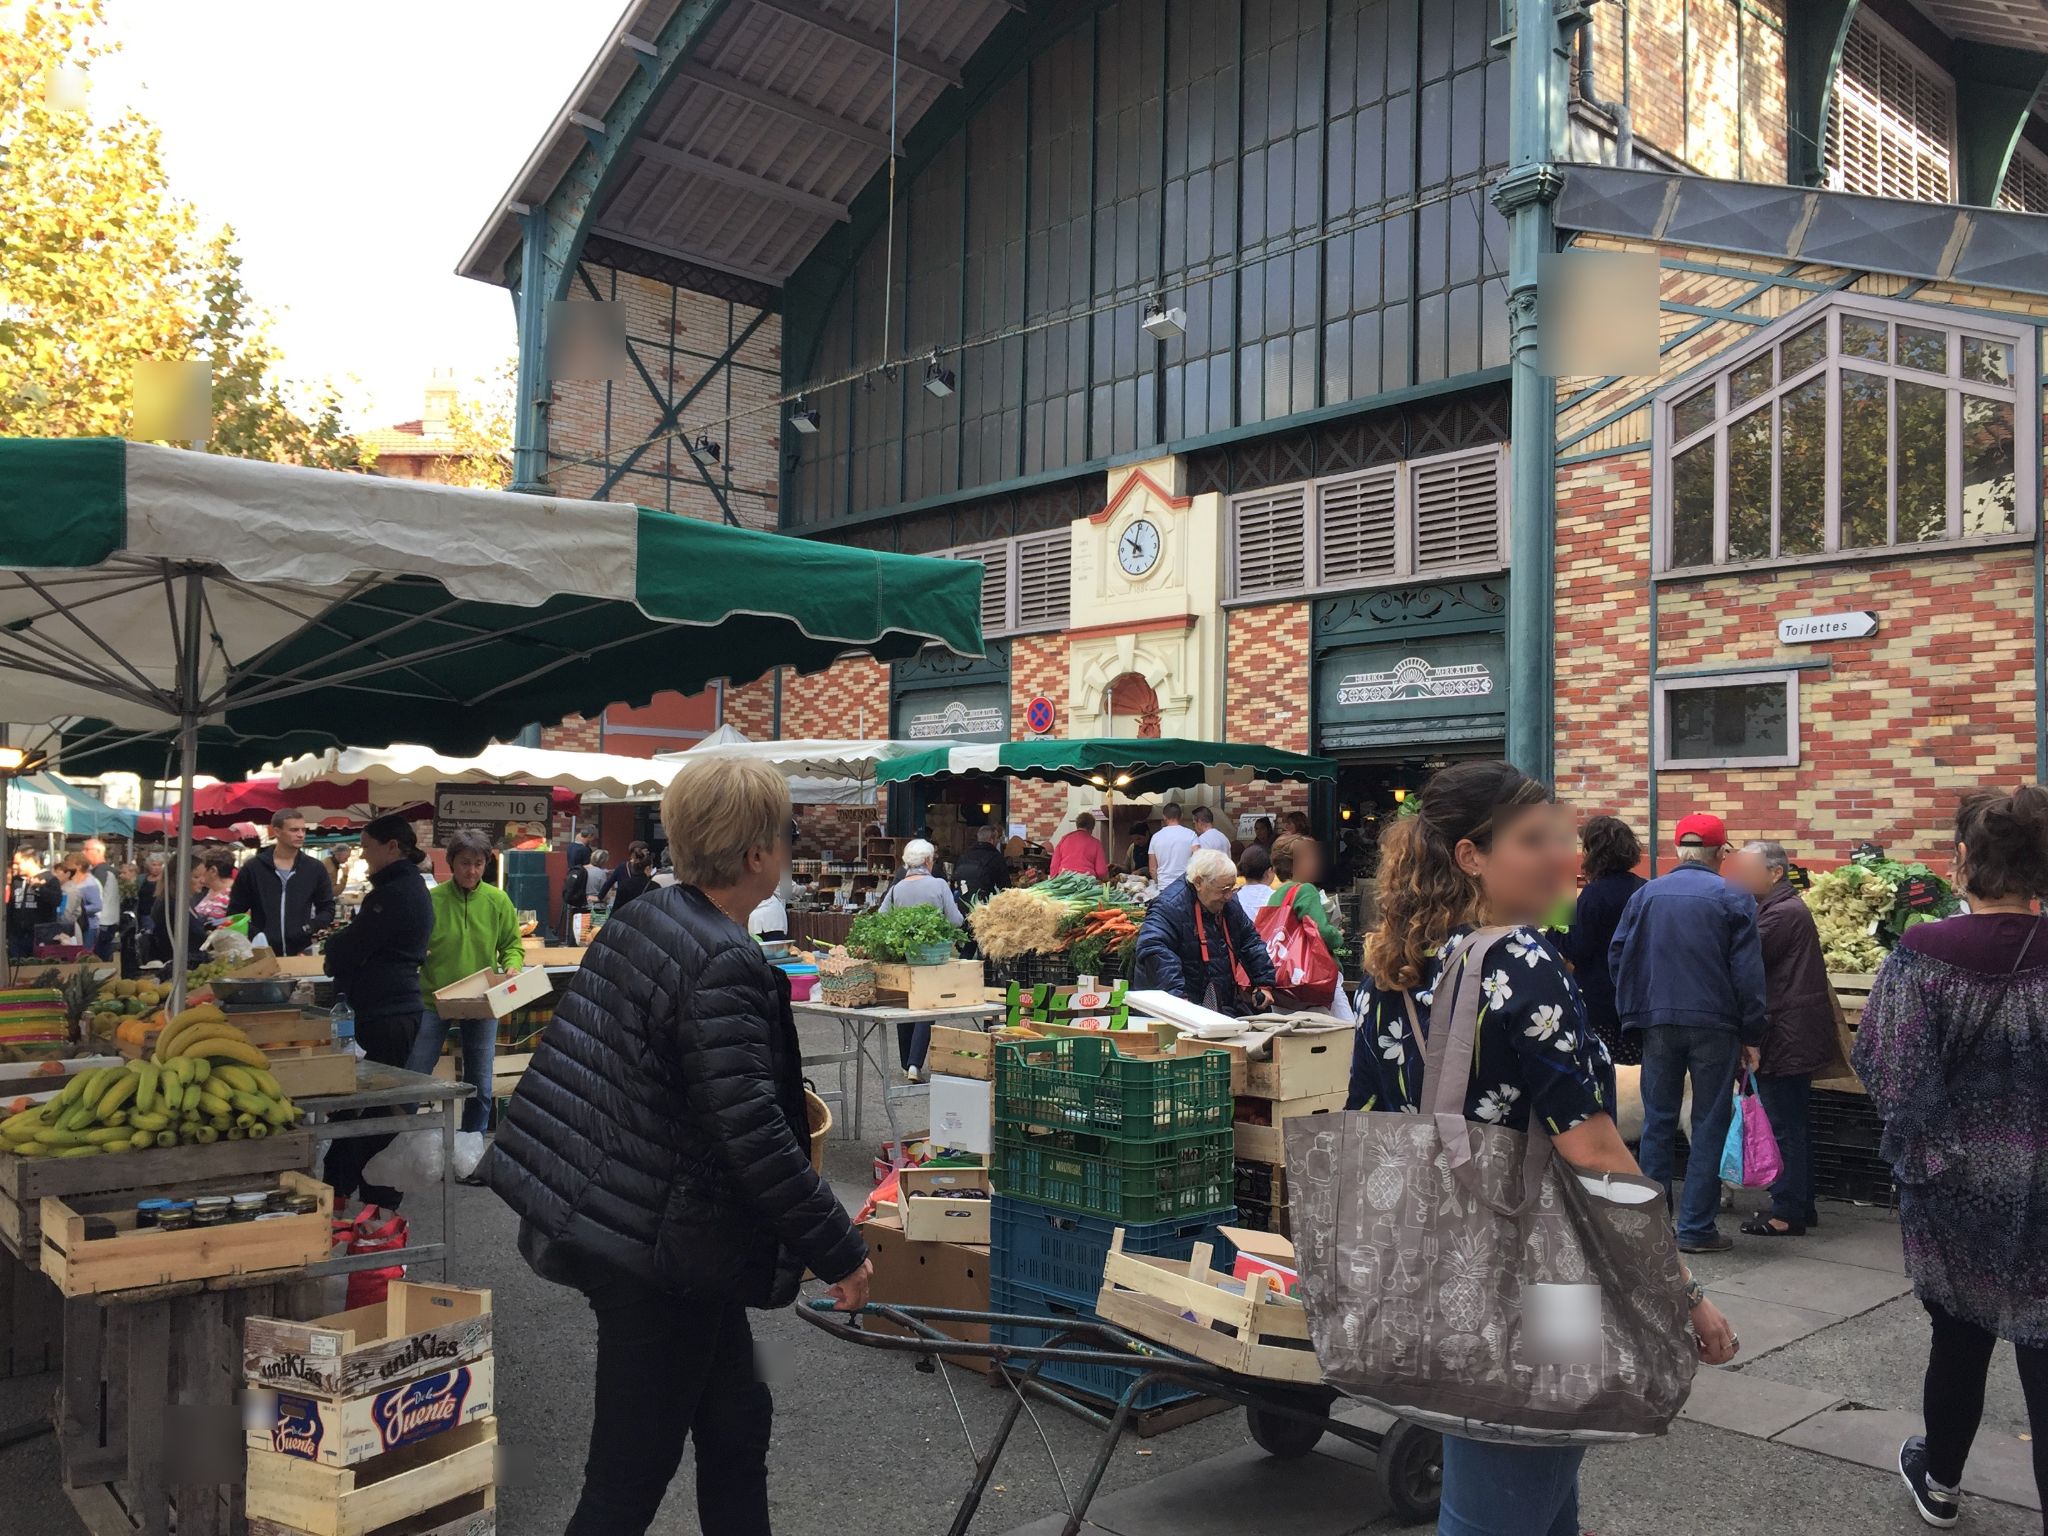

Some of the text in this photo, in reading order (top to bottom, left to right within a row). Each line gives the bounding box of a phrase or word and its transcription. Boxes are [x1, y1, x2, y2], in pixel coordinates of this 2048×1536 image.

[1785, 621, 1848, 637] Toilettes
[443, 800, 455, 815] 4
[509, 801, 526, 815] 10
[533, 802, 545, 815] €
[1081, 995, 1100, 1006] TROPS
[1081, 1019, 1100, 1031] TROPS
[384, 1383, 457, 1445] Fuente
[276, 1416, 315, 1455] Fuente
